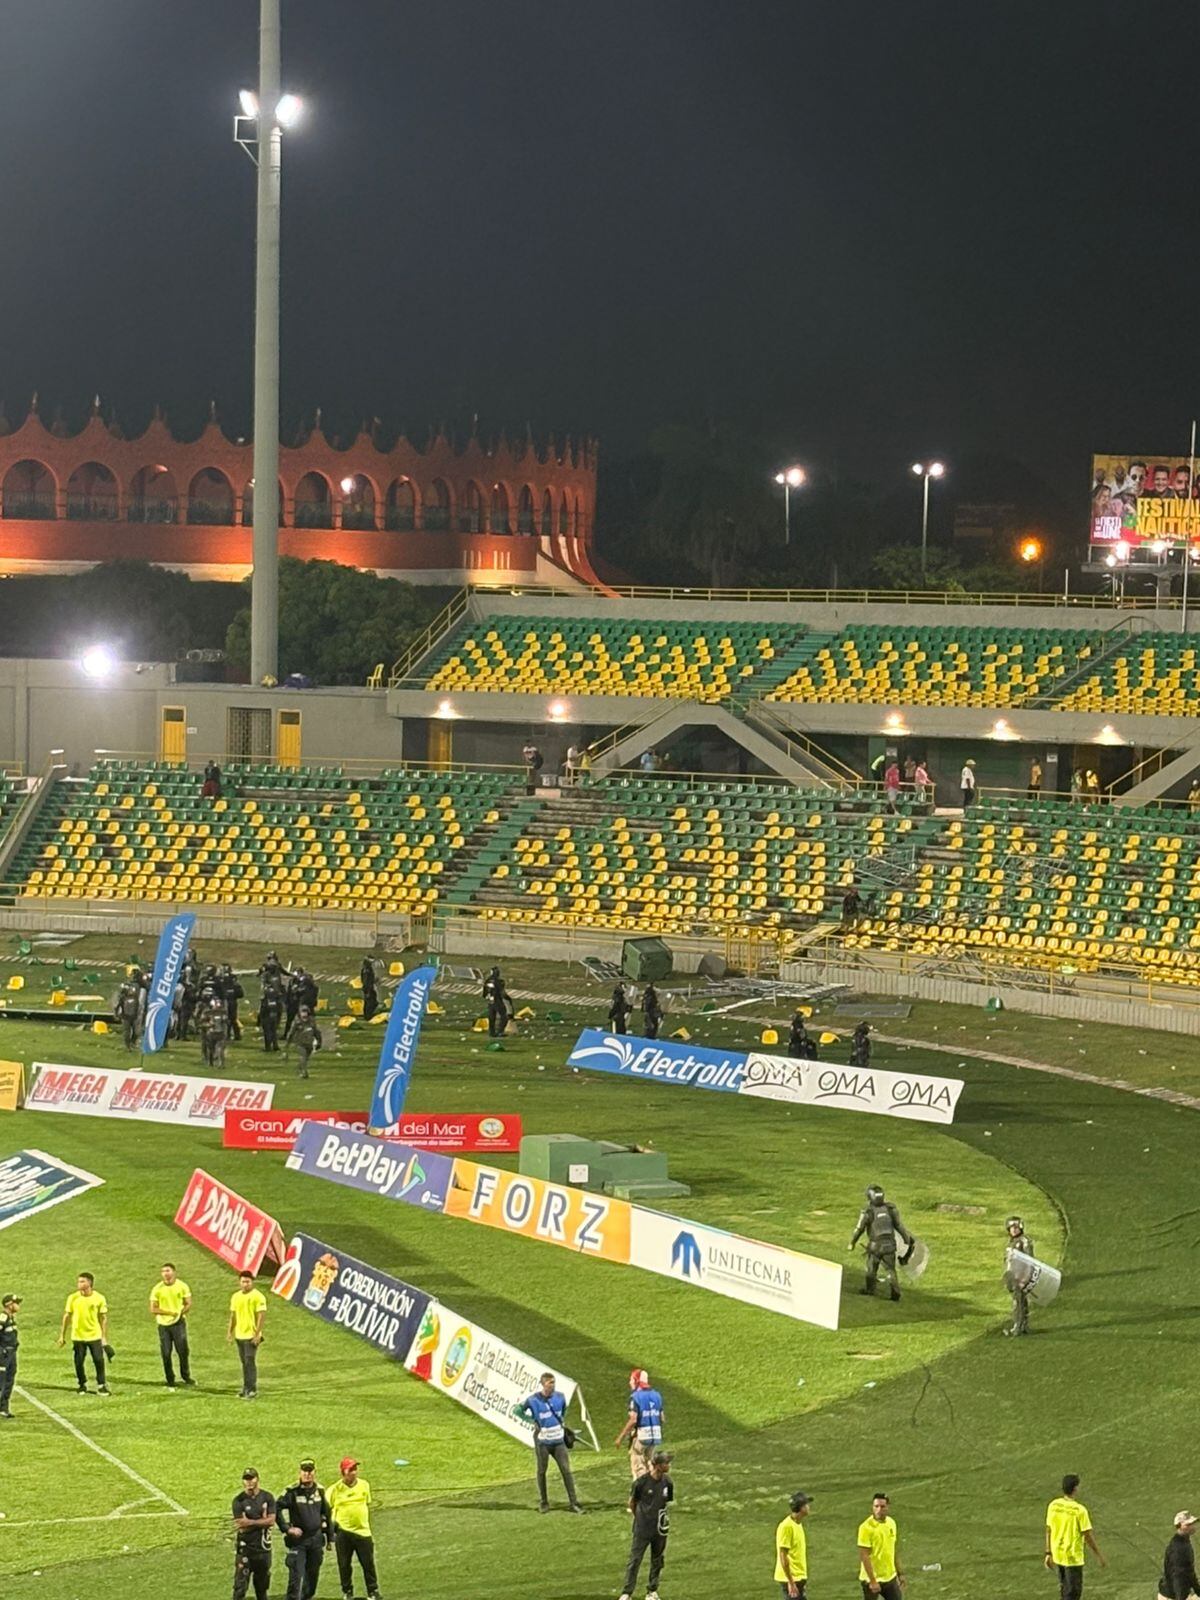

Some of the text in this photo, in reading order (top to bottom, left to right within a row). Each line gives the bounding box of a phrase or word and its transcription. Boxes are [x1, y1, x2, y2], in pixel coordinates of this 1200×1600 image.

[156, 923, 189, 997] Electrolit
[393, 979, 427, 1064] Electrolit
[43, 1071, 109, 1093] MEGA
[630, 1047, 745, 1088] Electrolit
[748, 1061, 802, 1086] OMA
[818, 1071, 876, 1096] OMA
[62, 1090, 101, 1104] TIENDAS
[119, 1078, 187, 1100] MEGA
[141, 1098, 180, 1111] TIENDAS
[200, 1085, 268, 1108] MEGA
[891, 1080, 951, 1106] OMA
[240, 1117, 466, 1135] Gran Mlecn del Mar
[316, 1134, 406, 1194] BetPlay
[469, 1168, 610, 1250] FORZ
[708, 1247, 792, 1287] UNITECNAR
[339, 1267, 415, 1318] GOBERNACIÓN
[328, 1294, 399, 1349] DE BOLÍVAR
[474, 1341, 512, 1379] Alcaldía
[463, 1372, 510, 1411] Cartagena
